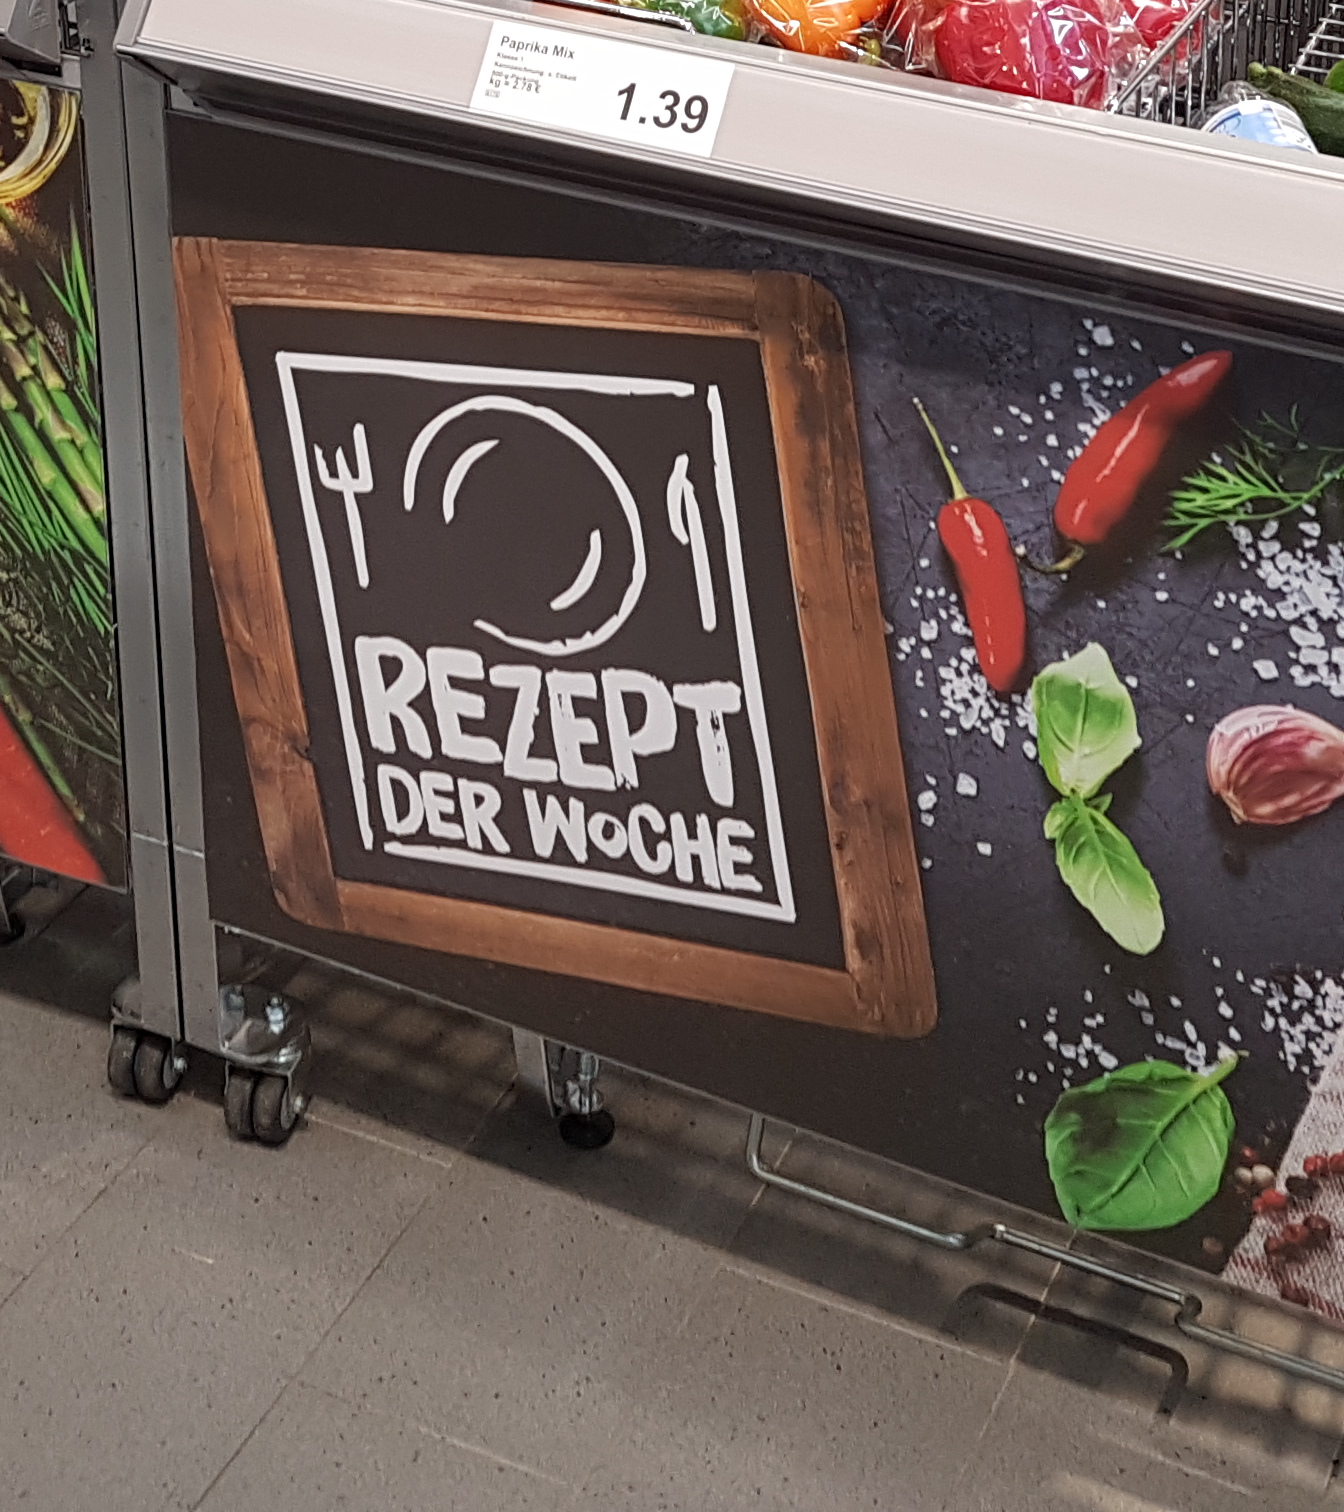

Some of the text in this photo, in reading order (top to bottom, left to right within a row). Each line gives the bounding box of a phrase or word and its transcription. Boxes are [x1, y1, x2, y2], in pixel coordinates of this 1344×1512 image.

[500, 35, 575, 59] Paprika Mix
[617, 82, 710, 134] 1.39
[354, 636, 743, 807] REZEPT
[377, 764, 763, 892] DER WOCHE
